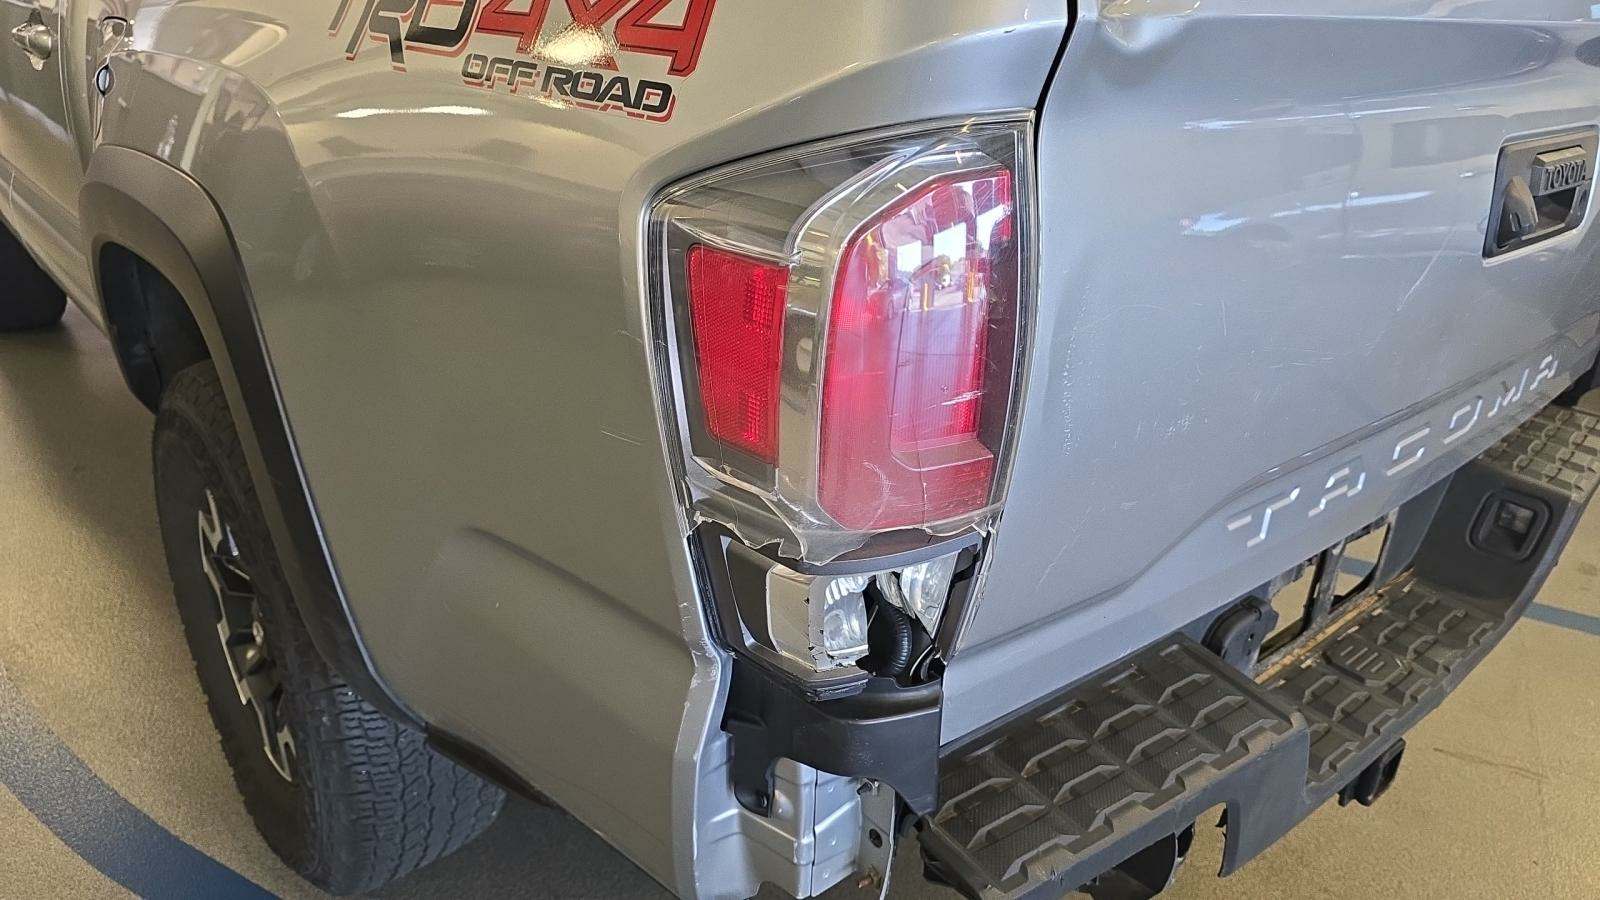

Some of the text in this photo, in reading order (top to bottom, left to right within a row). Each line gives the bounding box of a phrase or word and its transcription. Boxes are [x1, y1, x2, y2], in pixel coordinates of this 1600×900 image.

[461, 53, 677, 123] OFF ROAD
[1545, 160, 1587, 191] TOYOTA
[1227, 354, 1558, 548] TACOMA
